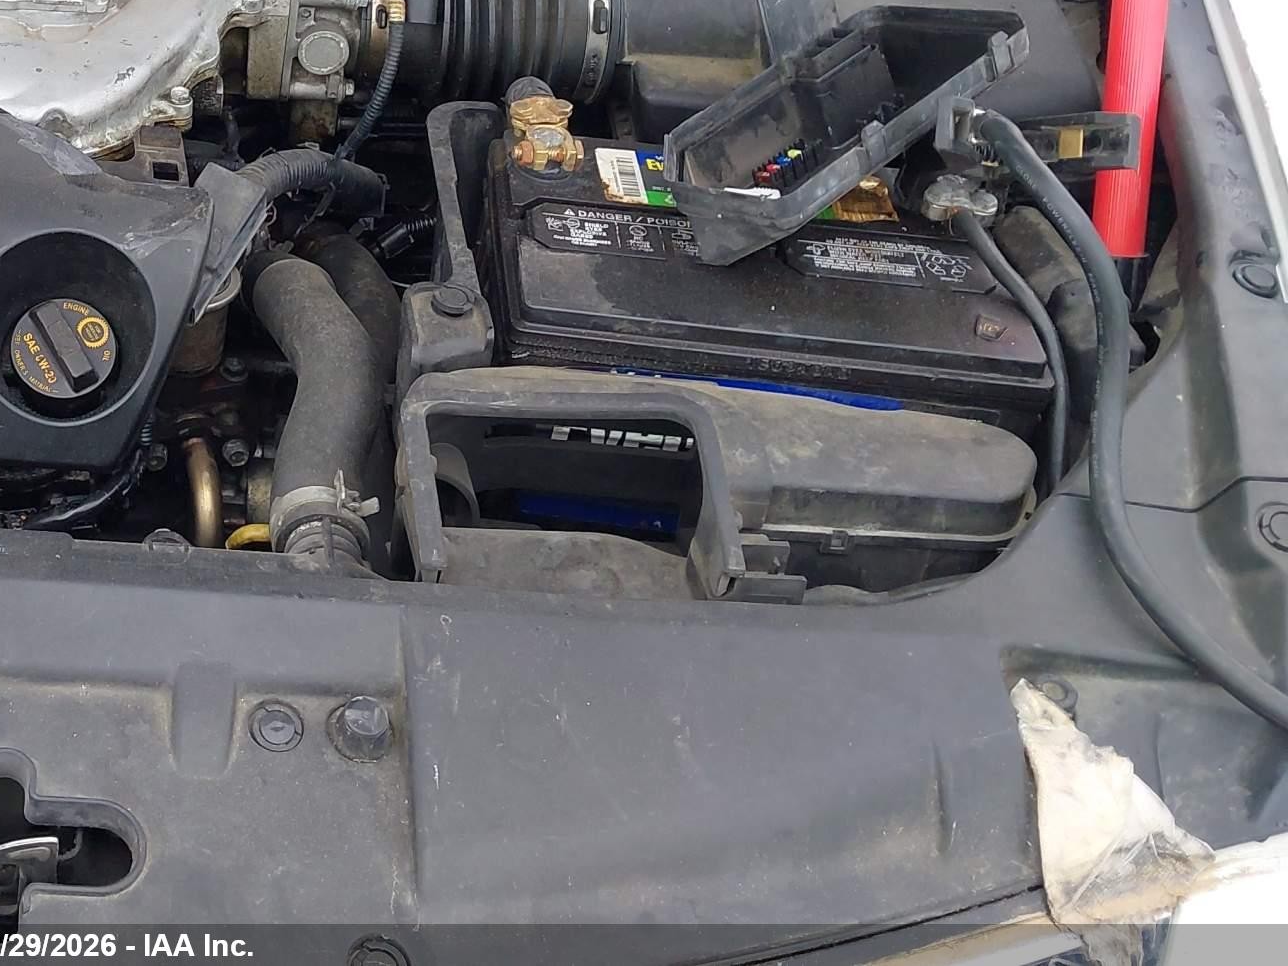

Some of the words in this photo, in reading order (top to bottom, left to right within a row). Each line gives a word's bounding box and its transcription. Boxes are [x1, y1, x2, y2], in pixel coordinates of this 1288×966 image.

[578, 209, 632, 222] DANGER
[23, 332, 41, 355] SAE
[35, 354, 57, 384] 0W-20
[63, 302, 90, 316] ENGINE
[102, 350, 111, 362] OIL
